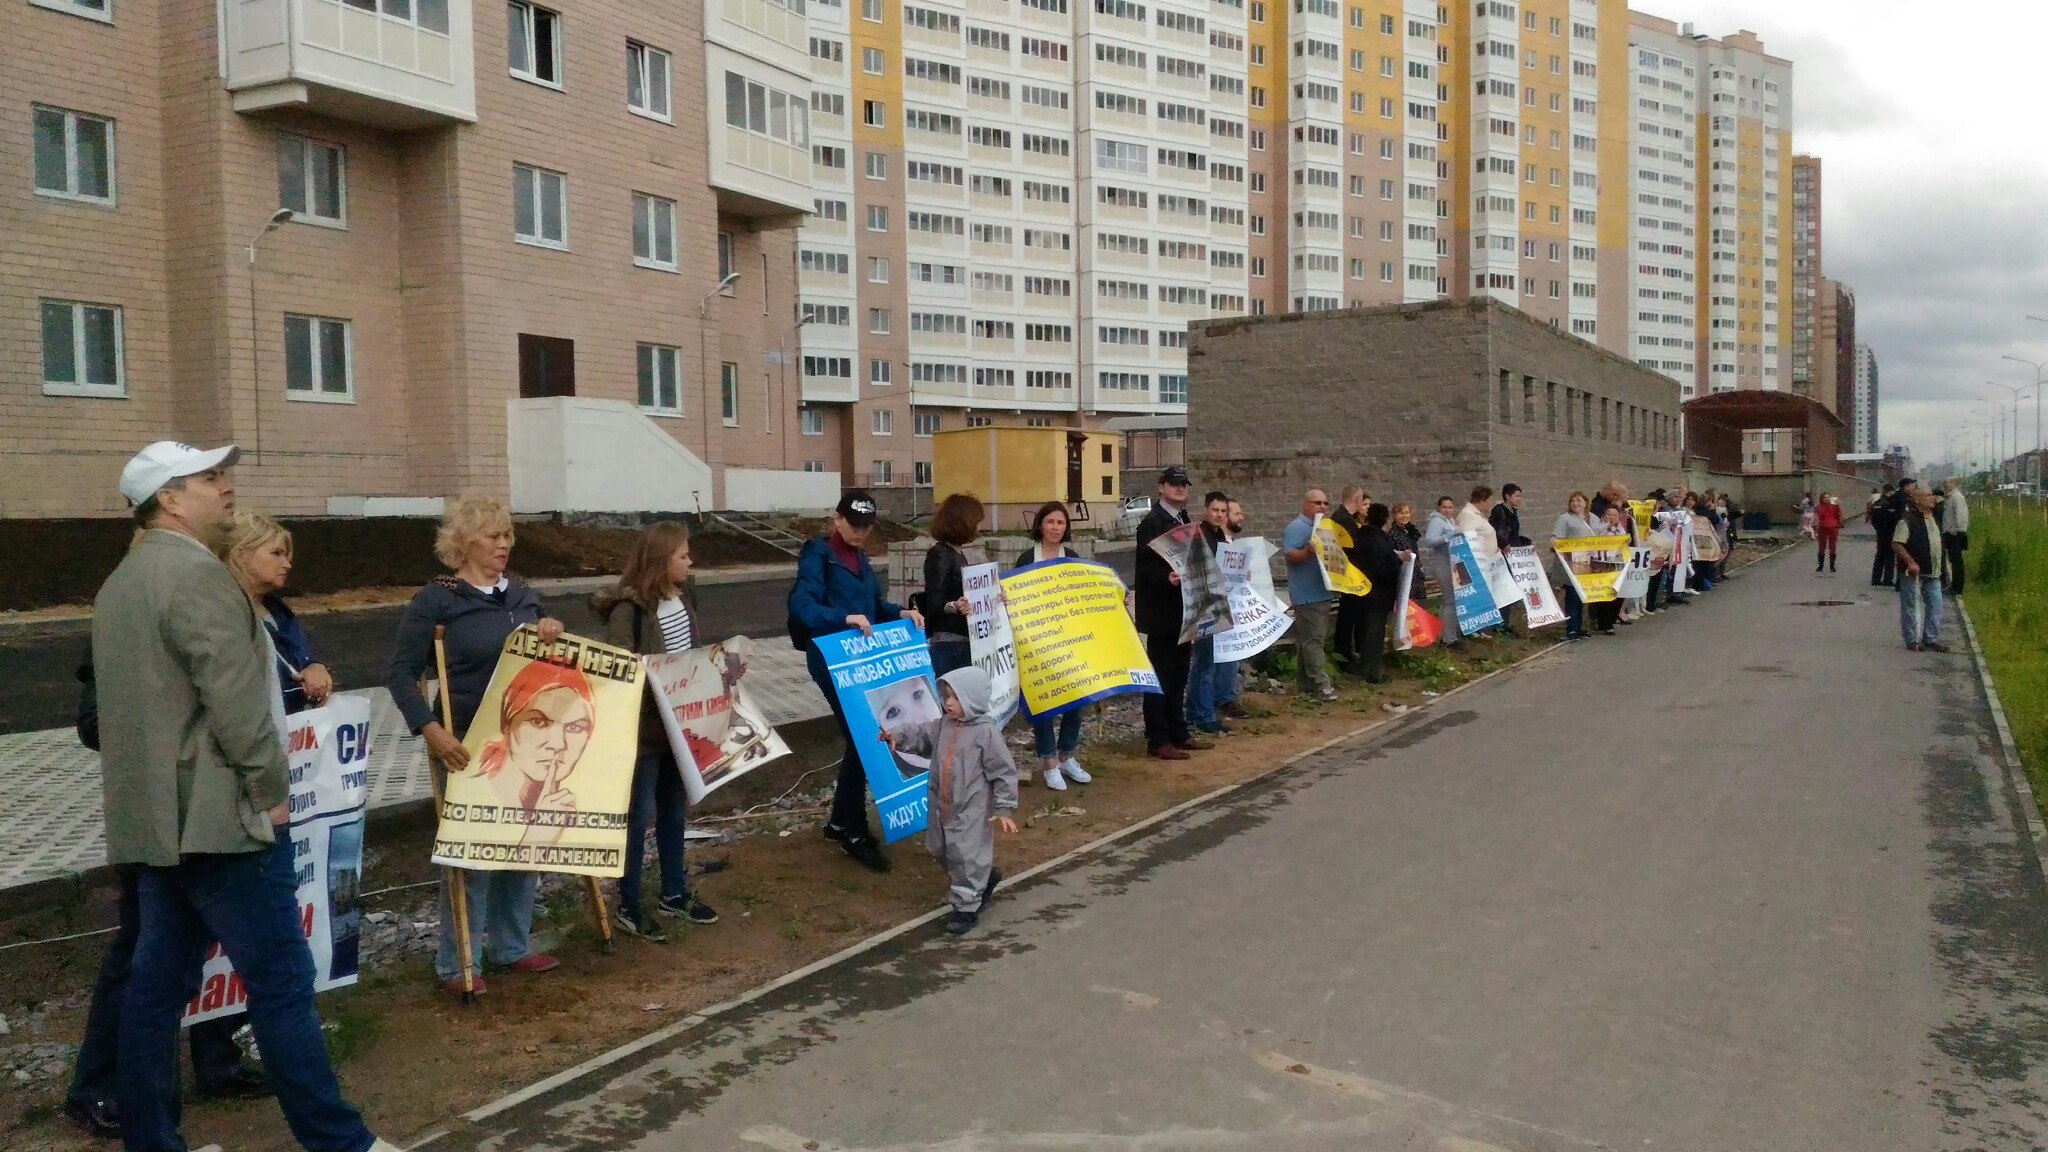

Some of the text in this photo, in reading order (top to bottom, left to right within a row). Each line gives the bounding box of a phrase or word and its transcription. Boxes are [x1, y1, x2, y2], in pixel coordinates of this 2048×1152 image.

[1513, 572, 1539, 583] ОРОДА
[1006, 590, 1042, 607] арталы
[1042, 581, 1098, 598] несбывшихся
[1020, 600, 1064, 618] квартиры
[1064, 593, 1080, 605] без
[1080, 591, 1116, 603] протечек!
[1012, 603, 1118, 634] на квартиры без плесени!
[1460, 608, 1501, 631] БУДУЩЕГО
[886, 626, 912, 649] ДЕТИ
[1017, 624, 1064, 647] на школы!
[1022, 650, 1034, 661] на
[1034, 631, 1096, 657] поликлиники!
[506, 628, 582, 670] ДЕНЕГ
[582, 645, 637, 683] НЕТ!
[1028, 664, 1040, 675] на
[1040, 651, 1076, 672] дороги!
[833, 669, 857, 690] ЖК
[1032, 677, 1045, 688] на
[1045, 661, 1089, 683] паркинги!
[1038, 691, 1050, 702] на
[1050, 673, 1101, 699] достойную
[1101, 666, 1129, 680] жизнь!
[288, 790, 317, 814] бурге
[442, 801, 467, 822] НО
[470, 804, 498, 823] ВЫ
[885, 800, 922, 830] ЖДУТ
[433, 839, 620, 868] ЖК НОВАЯ КАМЕНКА
